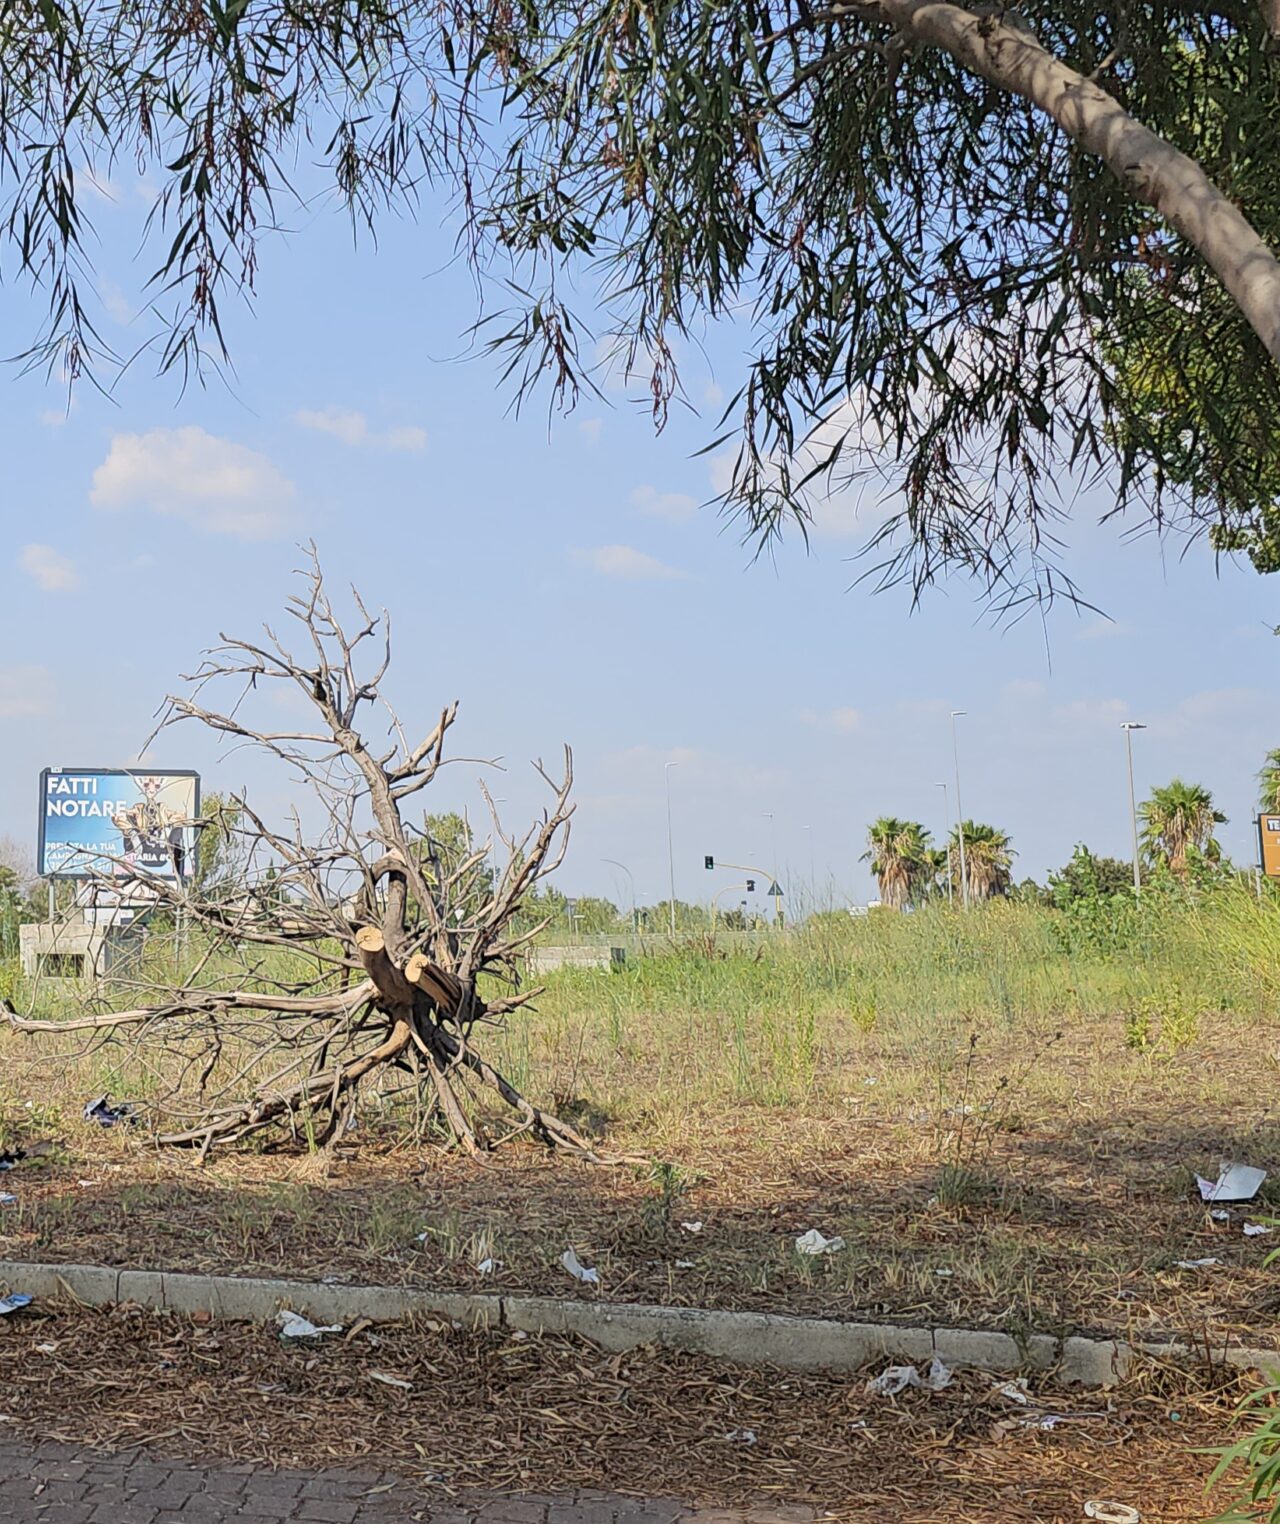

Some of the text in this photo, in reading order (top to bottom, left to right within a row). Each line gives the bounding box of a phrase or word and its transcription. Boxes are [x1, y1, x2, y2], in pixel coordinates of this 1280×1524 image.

[47, 777, 97, 794] FATTI
[47, 799, 127, 817] NOTARE
[100, 843, 116, 851] TUA
